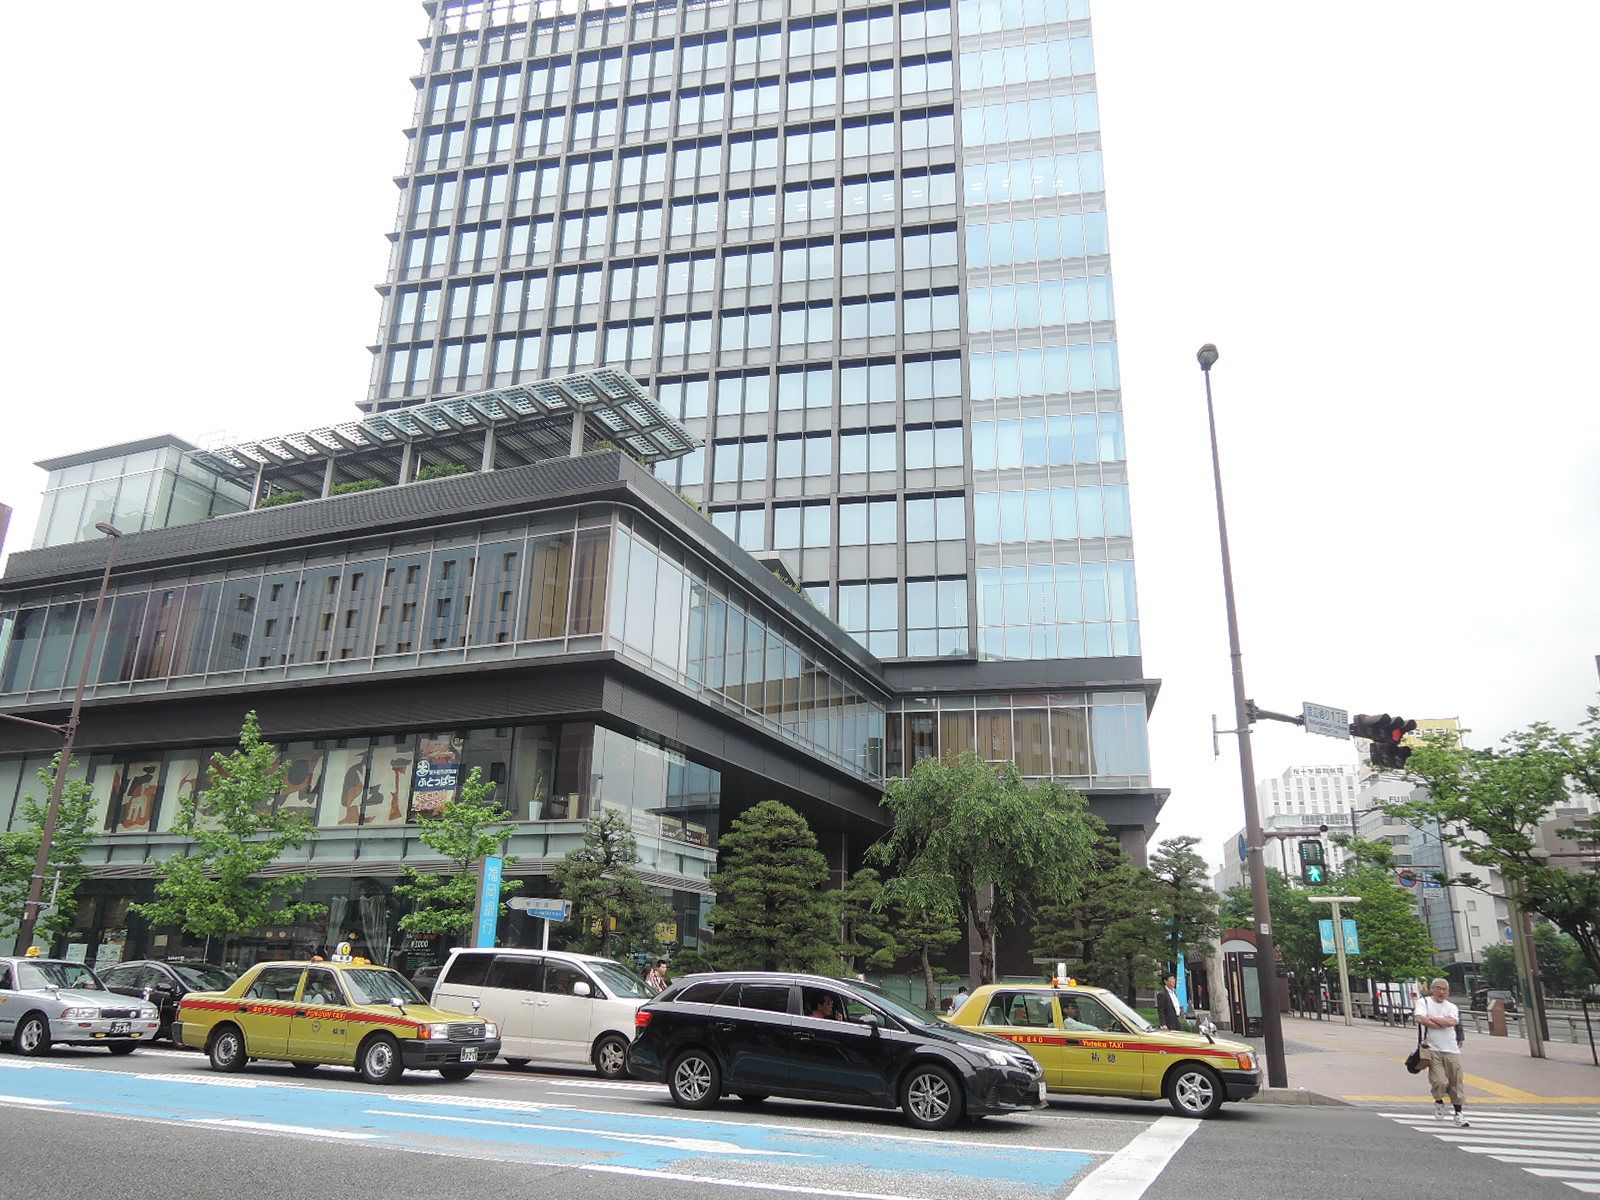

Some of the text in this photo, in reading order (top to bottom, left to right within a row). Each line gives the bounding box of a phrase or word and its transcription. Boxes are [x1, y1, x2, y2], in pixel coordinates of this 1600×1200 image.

[482, 865, 499, 935] 福岡銀行
[1109, 1041, 1124, 1049] TAXI
